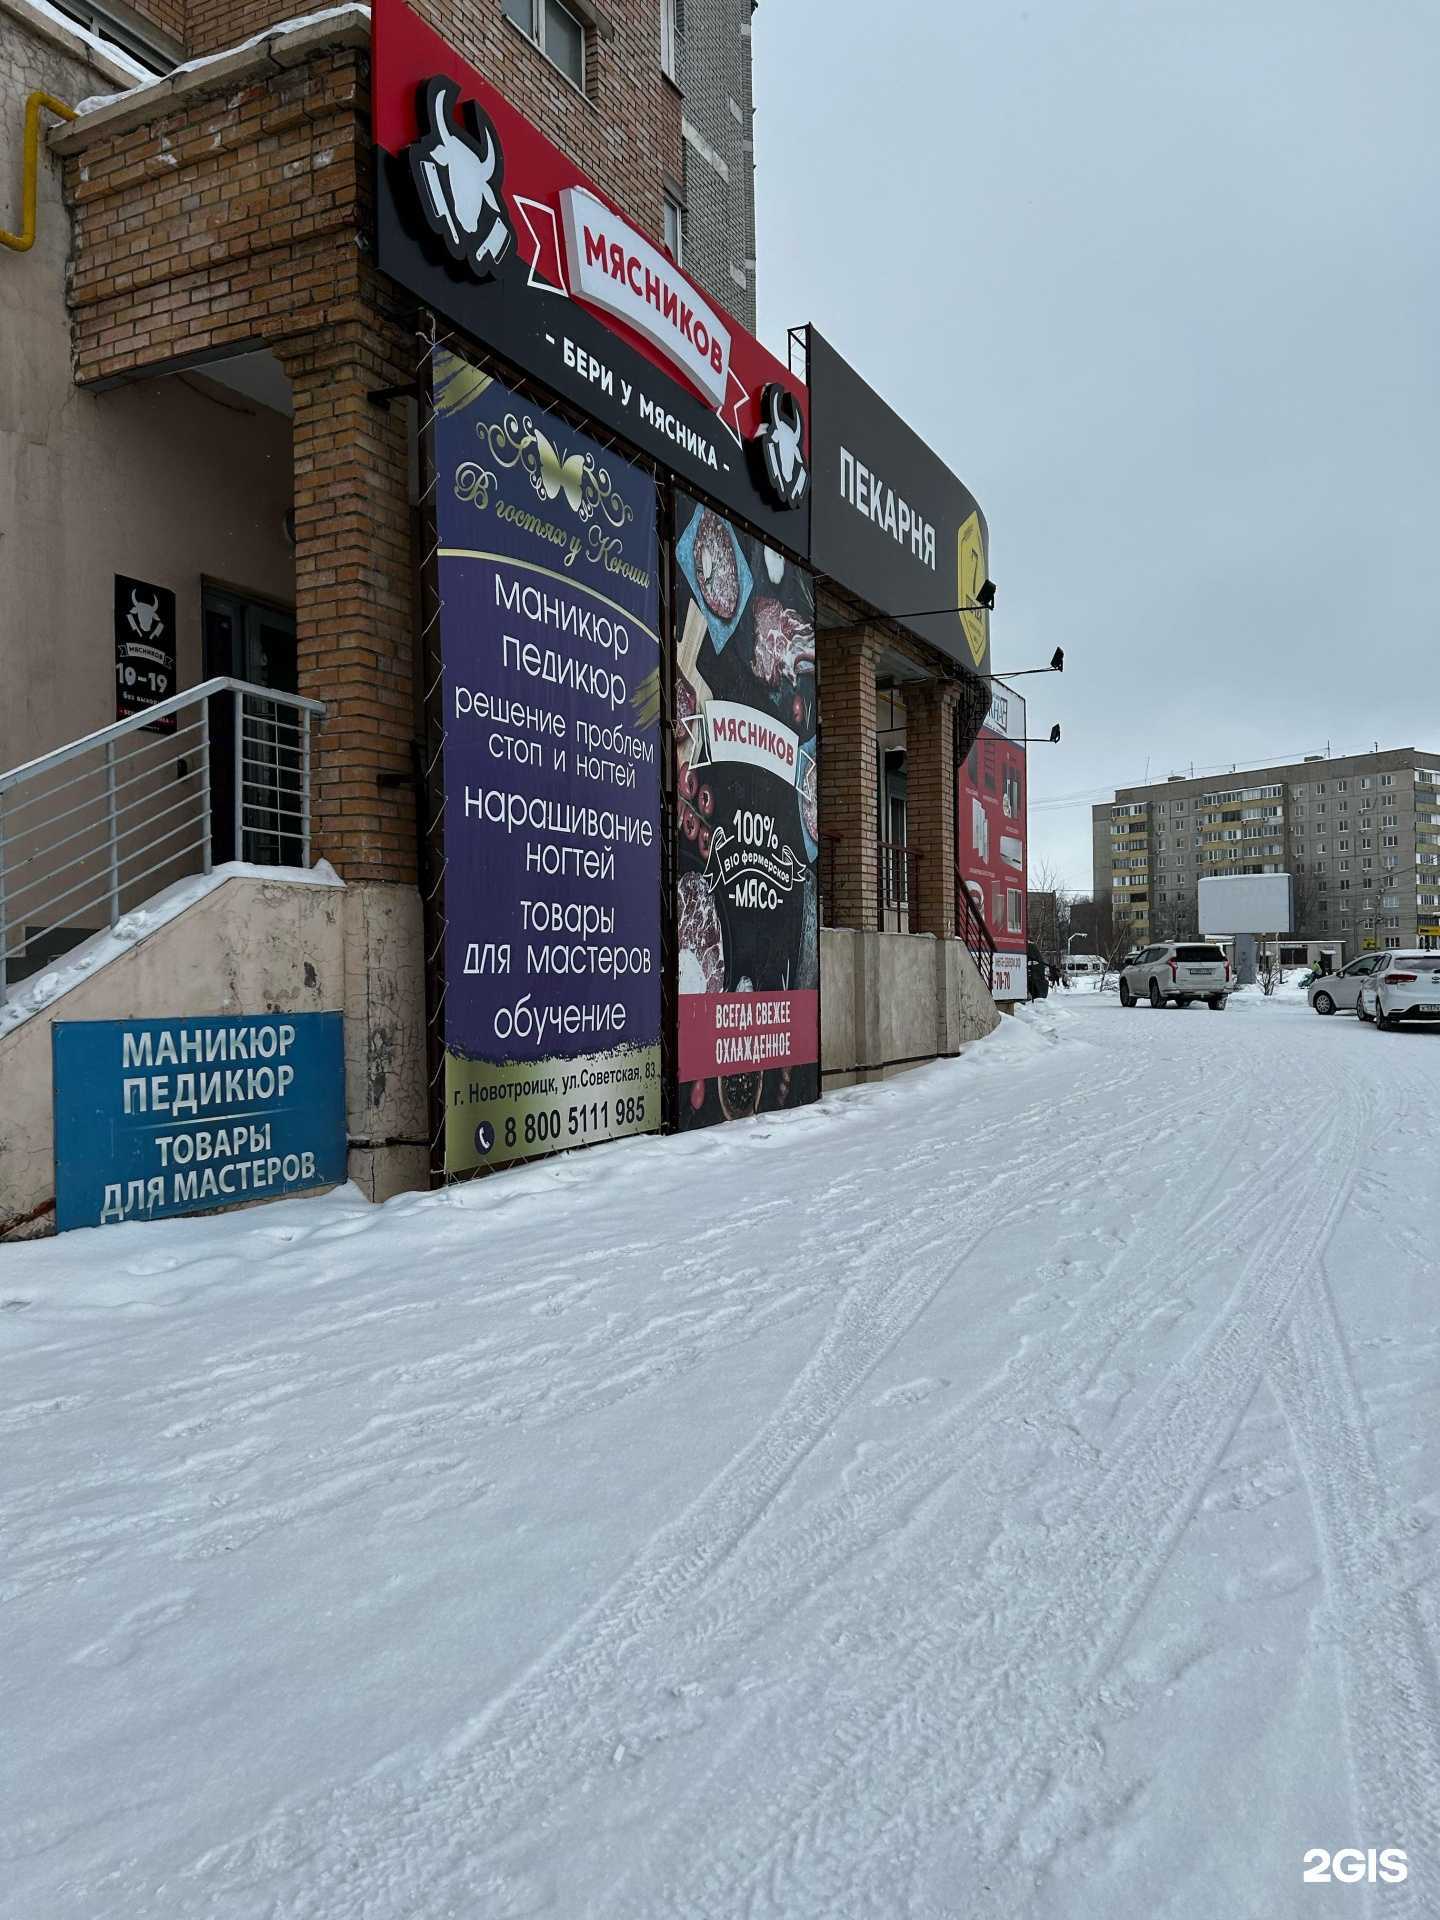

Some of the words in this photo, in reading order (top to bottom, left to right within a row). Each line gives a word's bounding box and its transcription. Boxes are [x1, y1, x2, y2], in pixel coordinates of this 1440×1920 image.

[583, 225, 724, 375] МЯСНИКОВ
[563, 336, 614, 396] БЕРИ
[620, 378, 632, 406] У
[639, 393, 718, 471] МЯСНИКА
[454, 461, 498, 510] В
[563, 535, 582, 567] у
[840, 446, 936, 571] ПЕКАРНЯ
[502, 634, 626, 711] педикюр
[455, 686, 566, 738] решение
[576, 719, 655, 764] проблем
[712, 717, 795, 767] МЯСНИКОВ
[488, 733, 542, 767] стоп
[554, 748, 566, 773] и
[576, 754, 637, 789] ногтей
[465, 786, 653, 847] наращивание
[733, 809, 779, 850] 100%
[526, 842, 615, 881] ногтей
[520, 900, 615, 941] товары
[463, 943, 511, 974] для
[527, 944, 651, 980] мастеров
[494, 993, 627, 1045] обучение
[715, 1003, 752, 1031] ВСЕГДА
[755, 1001, 791, 1026] СВЕЖЕЕ
[123, 1025, 295, 1068] МАНИКЮР
[715, 1032, 791, 1065] ОХЛАЖДЕННОЕ
[124, 1066, 294, 1116] ПЕДИКЮР
[469, 1079, 558, 1104] Новотроицк,
[155, 1123, 270, 1166] ТОВАРЫ
[504, 1116, 517, 1147] 8
[524, 1109, 561, 1144] 800
[568, 1100, 609, 1135] 5111
[615, 1095, 646, 1126] 985
[100, 1175, 165, 1225] ДЛЯ
[174, 1152, 315, 1202] МАСТЕРОВ
